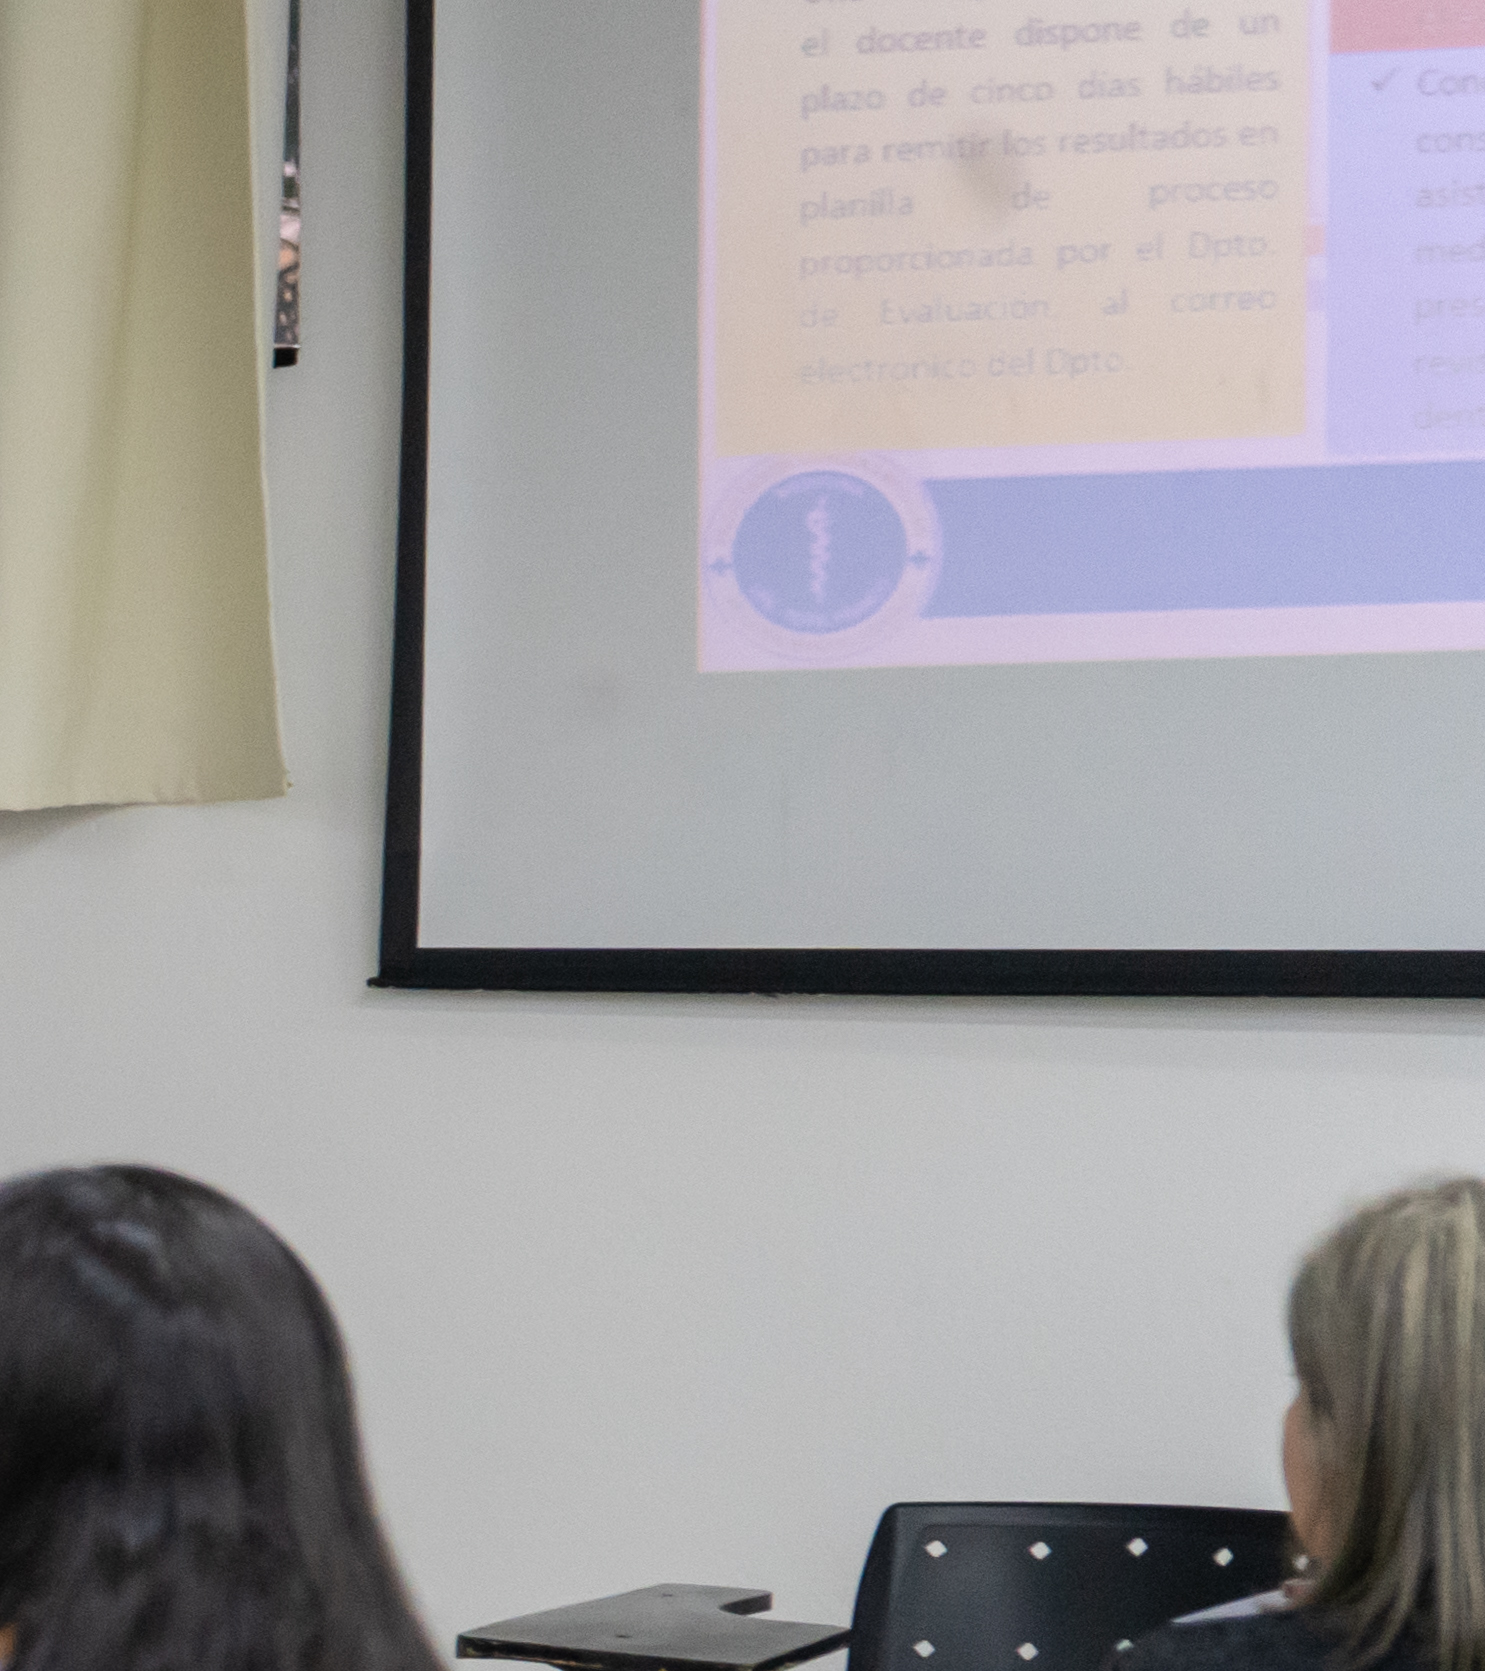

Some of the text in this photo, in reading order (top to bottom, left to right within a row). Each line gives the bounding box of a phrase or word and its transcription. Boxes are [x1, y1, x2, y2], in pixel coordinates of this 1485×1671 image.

[800, 8, 1280, 58] el docente dispone de un
[800, 84, 887, 121] plazo
[907, 79, 948, 109] de
[969, 75, 1055, 105] cinco
[1164, 63, 1282, 97] hábiles
[800, 119, 1281, 174] para remitir los resultados en
[800, 178, 1281, 227] planilla de proceso
[799, 238, 1034, 282] proporcionada
[1056, 241, 1111, 271] por
[1135, 231, 1165, 262] el
[800, 303, 839, 330] de
[1101, 287, 1131, 318] al
[1170, 289, 1278, 314] correo
[986, 346, 1037, 379] del
